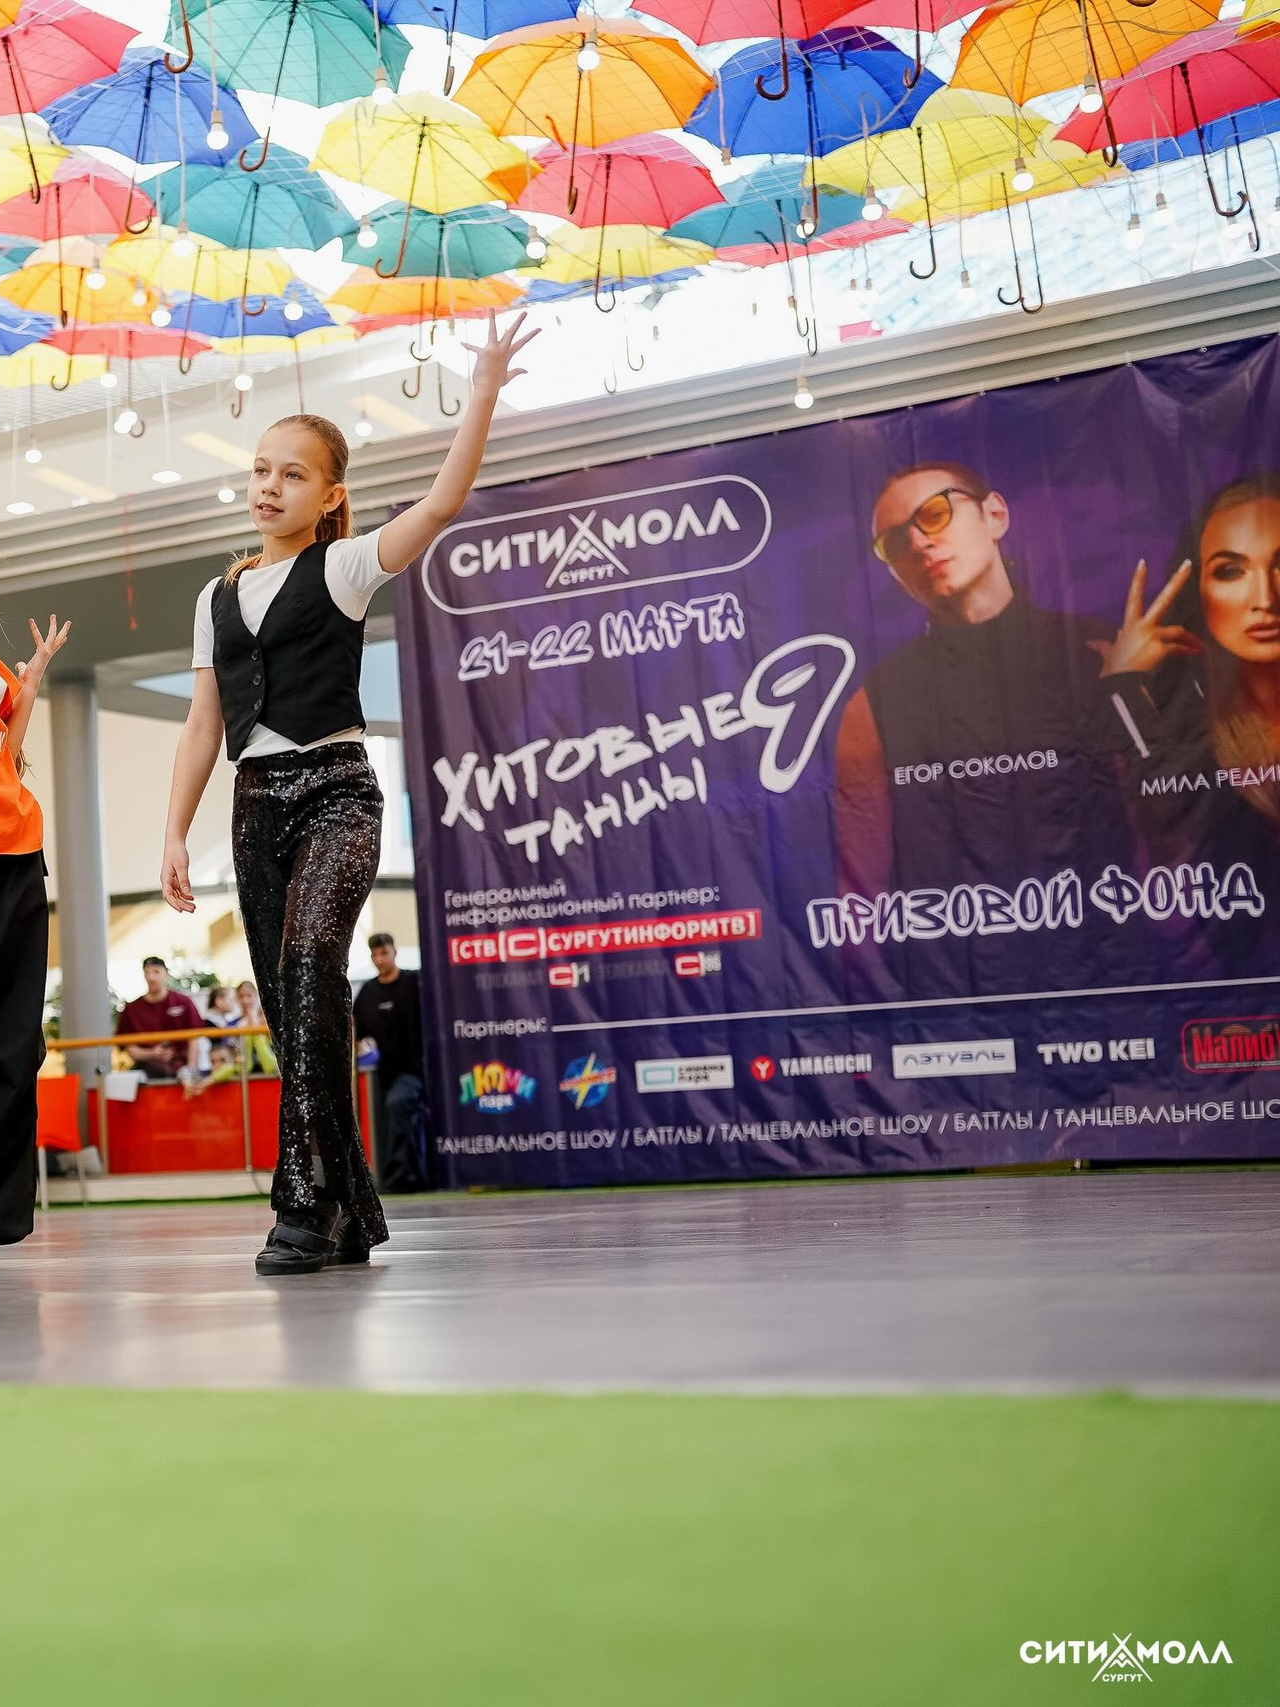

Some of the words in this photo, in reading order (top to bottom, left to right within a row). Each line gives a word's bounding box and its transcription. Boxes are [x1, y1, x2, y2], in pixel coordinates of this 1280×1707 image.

[558, 564, 615, 586] СУРГУТ
[457, 620, 594, 681] 21-22
[599, 592, 745, 659] МАРТА
[432, 691, 748, 832] ХИТОВЫЕ
[893, 762, 945, 785] ЕГОР
[947, 749, 1059, 780] СОКОЛОВ
[1140, 772, 1211, 797] МИЛА
[504, 757, 708, 863] ТАНЦЫ
[444, 878, 567, 909] Генеральный
[445, 892, 624, 928] информационный
[628, 886, 720, 911] партнер:
[806, 867, 1084, 949] ПРИЗОВОЙ
[1090, 861, 1266, 924] ФОНД
[453, 1017, 549, 1042] Партнеры:
[780, 1053, 872, 1077] YAMAGUCHI
[1037, 1040, 1104, 1066] TWO
[1108, 1037, 1157, 1062] KEI
[570, 1128, 618, 1150] ШОУ
[633, 1125, 703, 1147] БАТТЛЫ
[719, 1116, 876, 1143] ТАНЦЕВАЛЬНОЕ
[879, 1113, 934, 1136] ШОУ
[953, 1109, 1034, 1133] БАТТЛЫ
[1054, 1101, 1235, 1128] ТАНЦЕВАЛЬНОЕ
